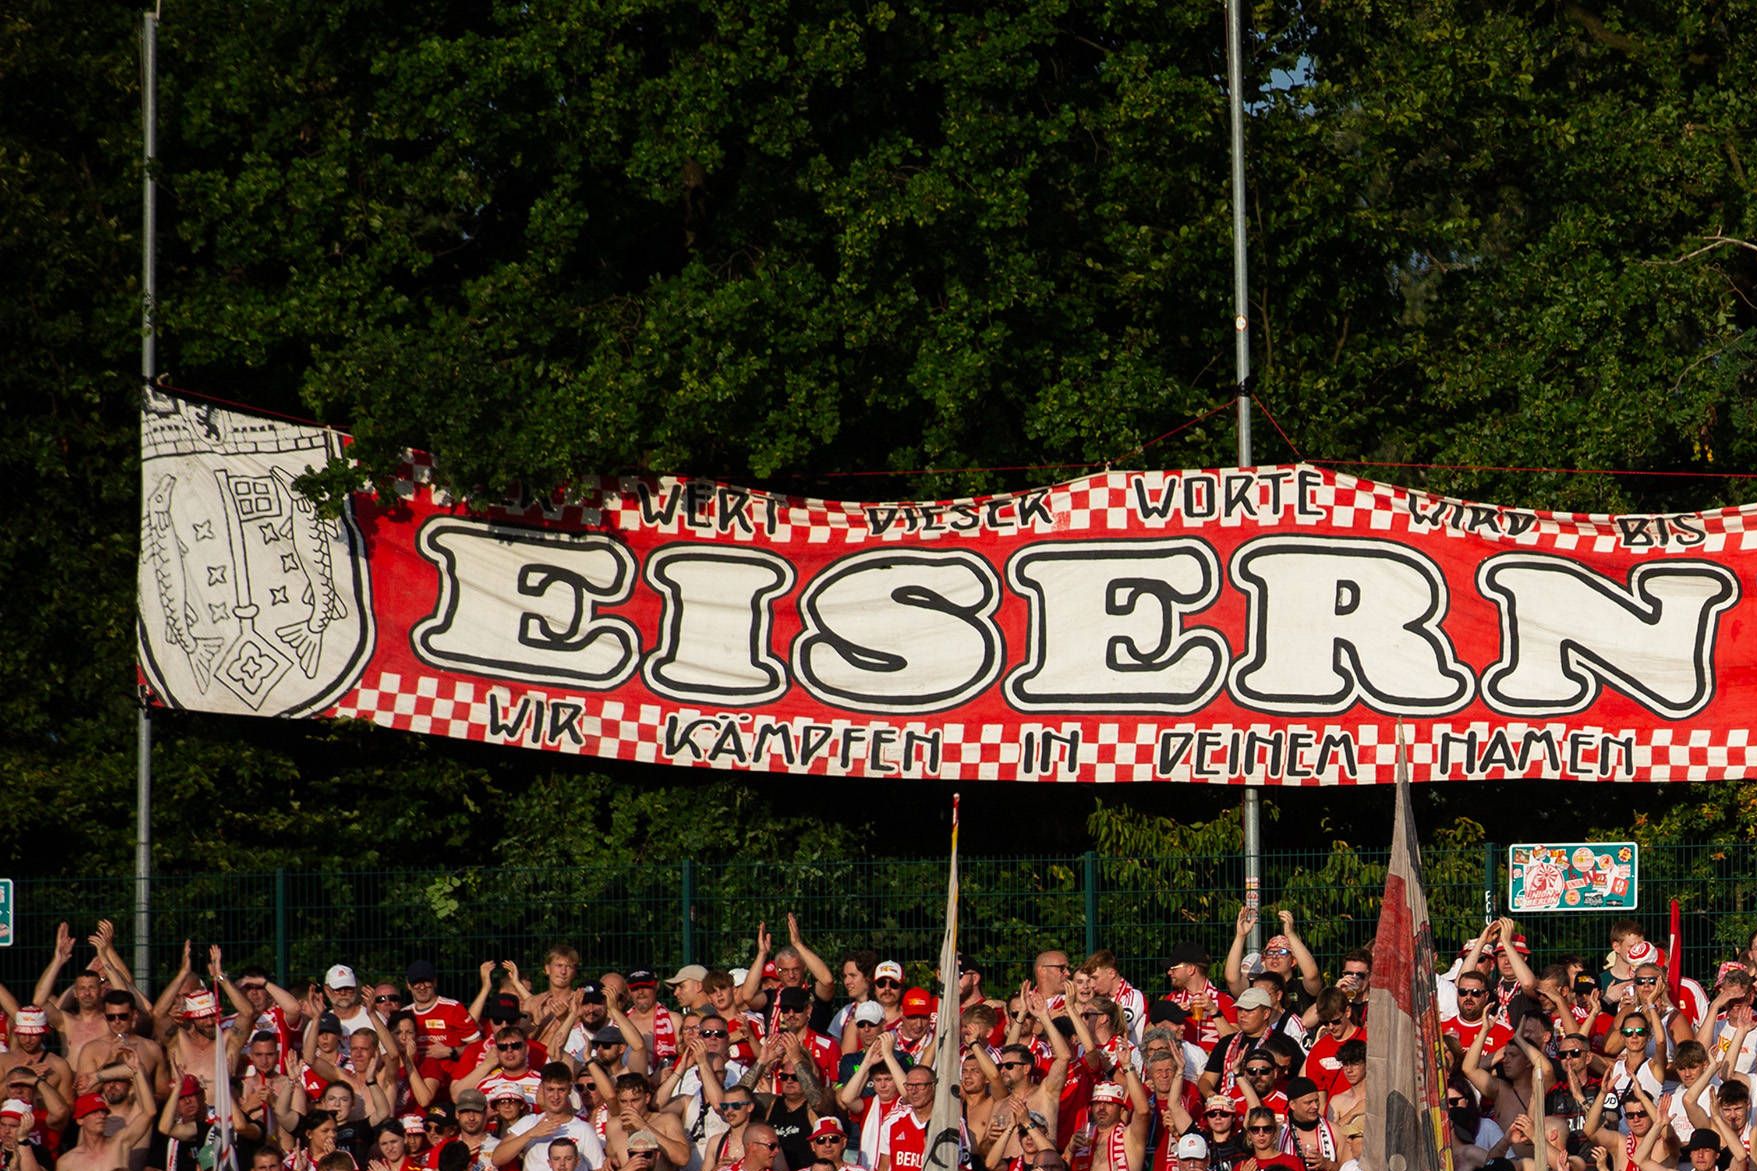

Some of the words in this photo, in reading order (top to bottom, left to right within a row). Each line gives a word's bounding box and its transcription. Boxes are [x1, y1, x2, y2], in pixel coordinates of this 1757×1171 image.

[637, 482, 782, 537] WERT
[865, 488, 1056, 535] DIESER
[1134, 471, 1325, 521] WORTE
[1406, 494, 1539, 536] WIRD
[1616, 514, 1706, 547] BIS
[409, 516, 1740, 717] EISERN
[487, 689, 586, 744] WIR
[664, 713, 943, 775] KÄMPFEN
[1022, 728, 1080, 774] IN
[1158, 732, 1358, 779] DEINEM
[1439, 730, 1636, 778] NAMEN
